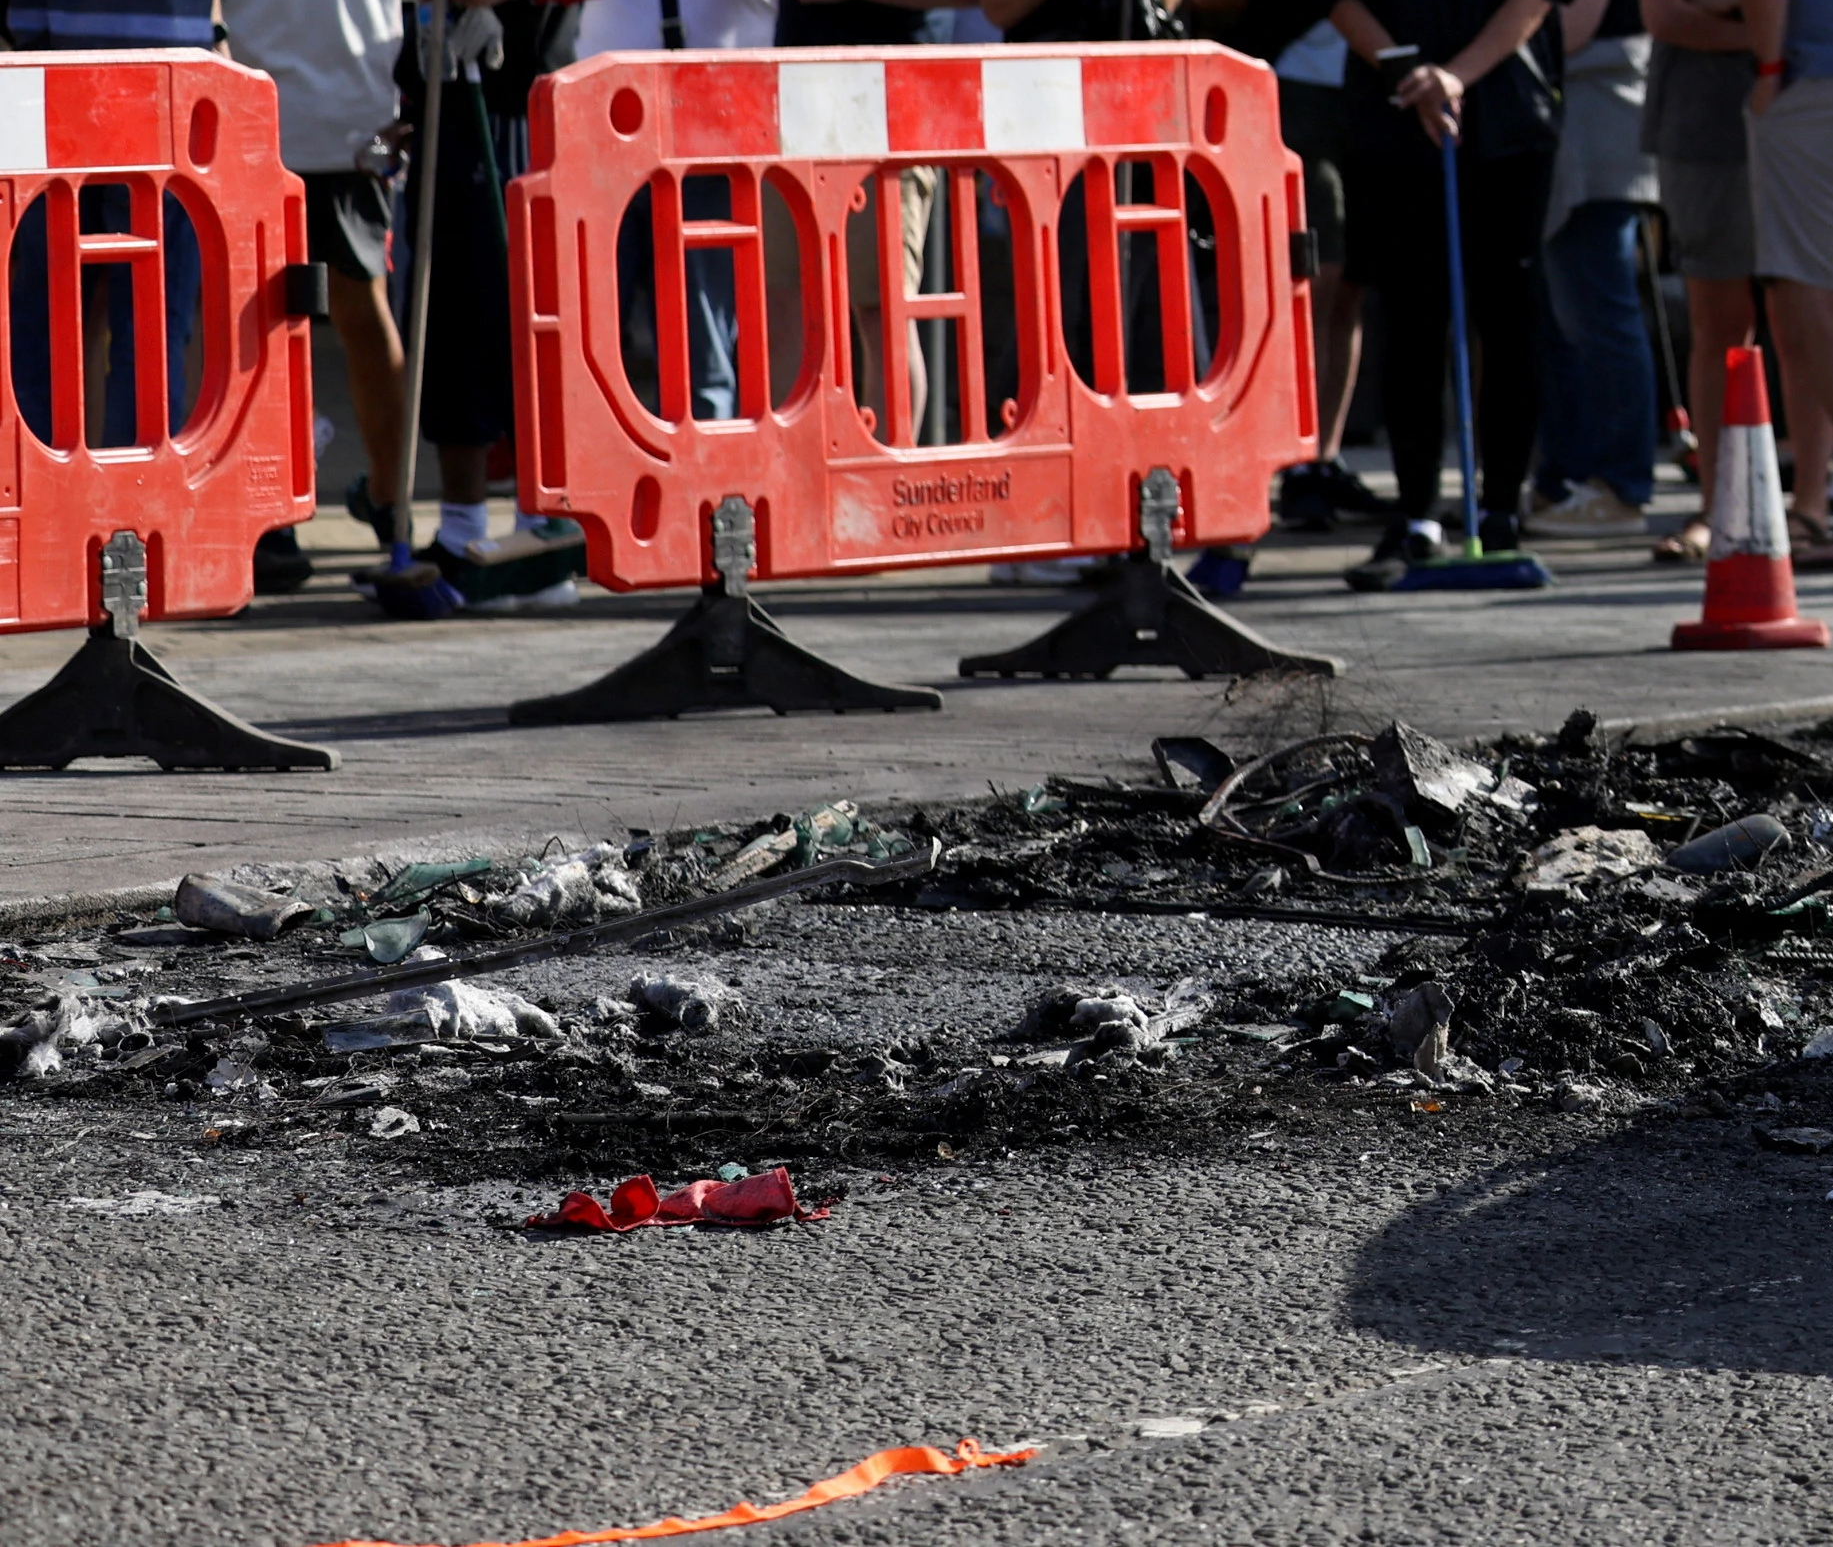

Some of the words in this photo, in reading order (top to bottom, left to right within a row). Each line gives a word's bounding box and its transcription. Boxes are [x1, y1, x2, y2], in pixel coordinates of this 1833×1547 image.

[893, 468, 1012, 507] Sunderland
[892, 512, 922, 539] City
[927, 510, 984, 536] Council
